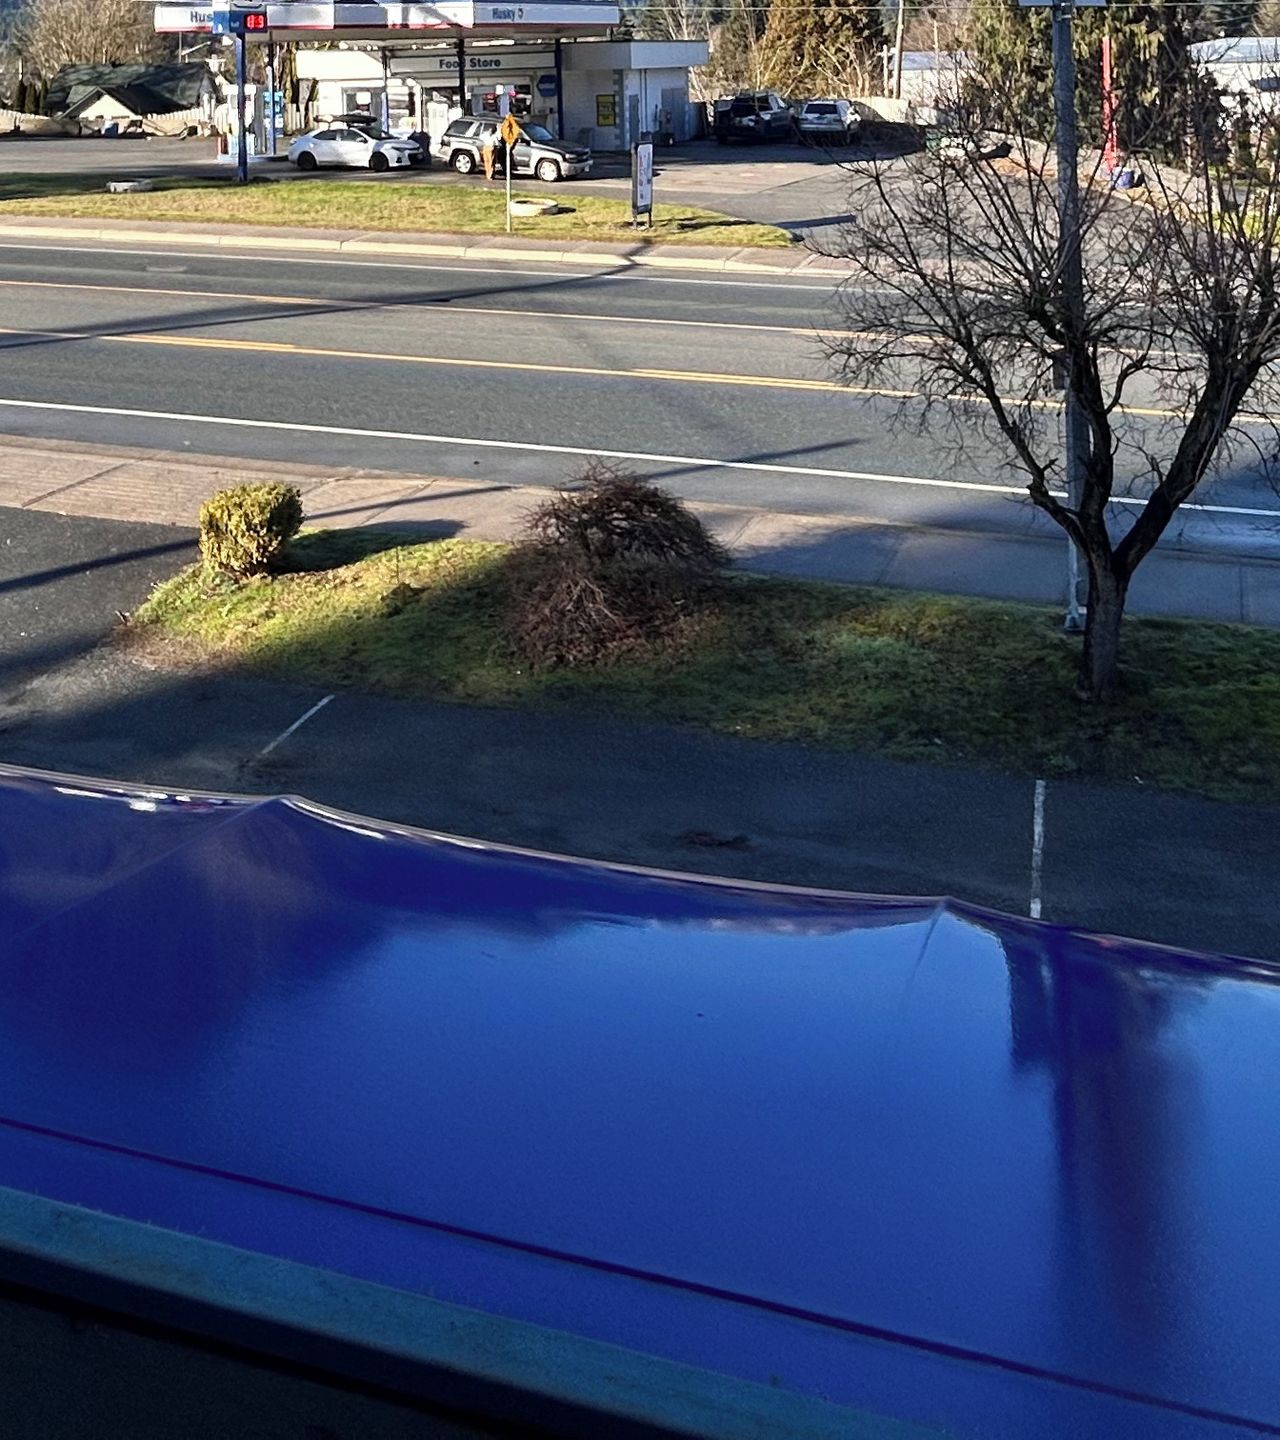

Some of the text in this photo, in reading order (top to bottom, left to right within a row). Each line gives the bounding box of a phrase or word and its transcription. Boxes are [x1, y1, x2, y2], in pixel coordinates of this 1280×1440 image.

[190, 10, 214, 23] Hus
[492, 7, 515, 21] Husky
[469, 57, 501, 68] Store
